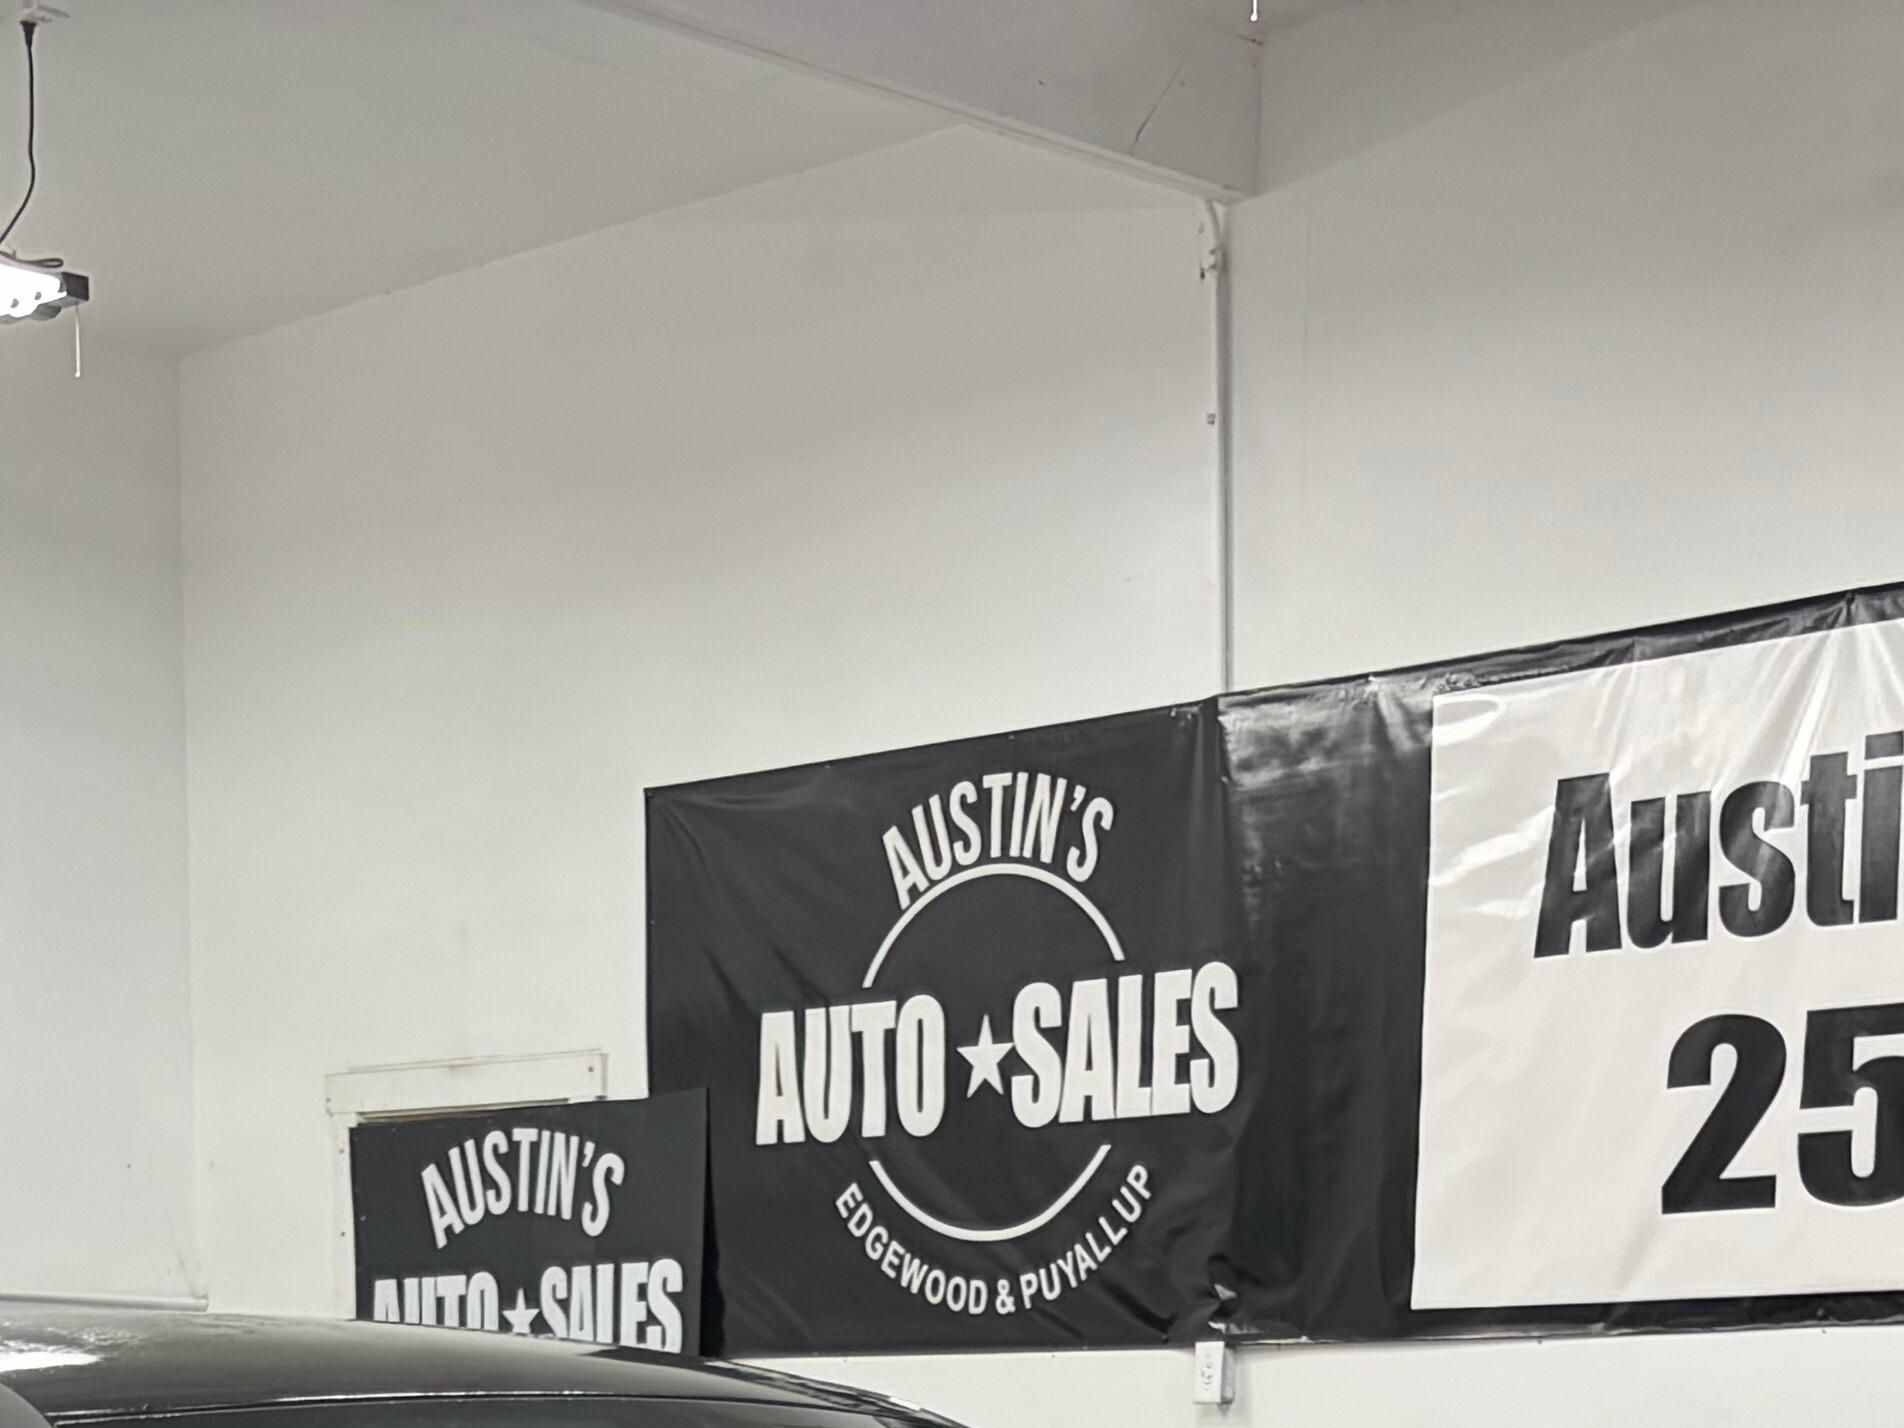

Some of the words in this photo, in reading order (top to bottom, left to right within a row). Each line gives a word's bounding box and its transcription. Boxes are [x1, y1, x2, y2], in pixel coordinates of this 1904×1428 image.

[881, 771, 1114, 911] AUSTIN'S
[755, 994, 946, 1146] AUTO
[1010, 960, 1240, 1129] SALES
[420, 1127, 625, 1250] AUSTIN'S
[834, 1182, 989, 1315] EDGEWOOD
[995, 1278, 1017, 1315] &
[1018, 1164, 1153, 1311] PUYALLUP
